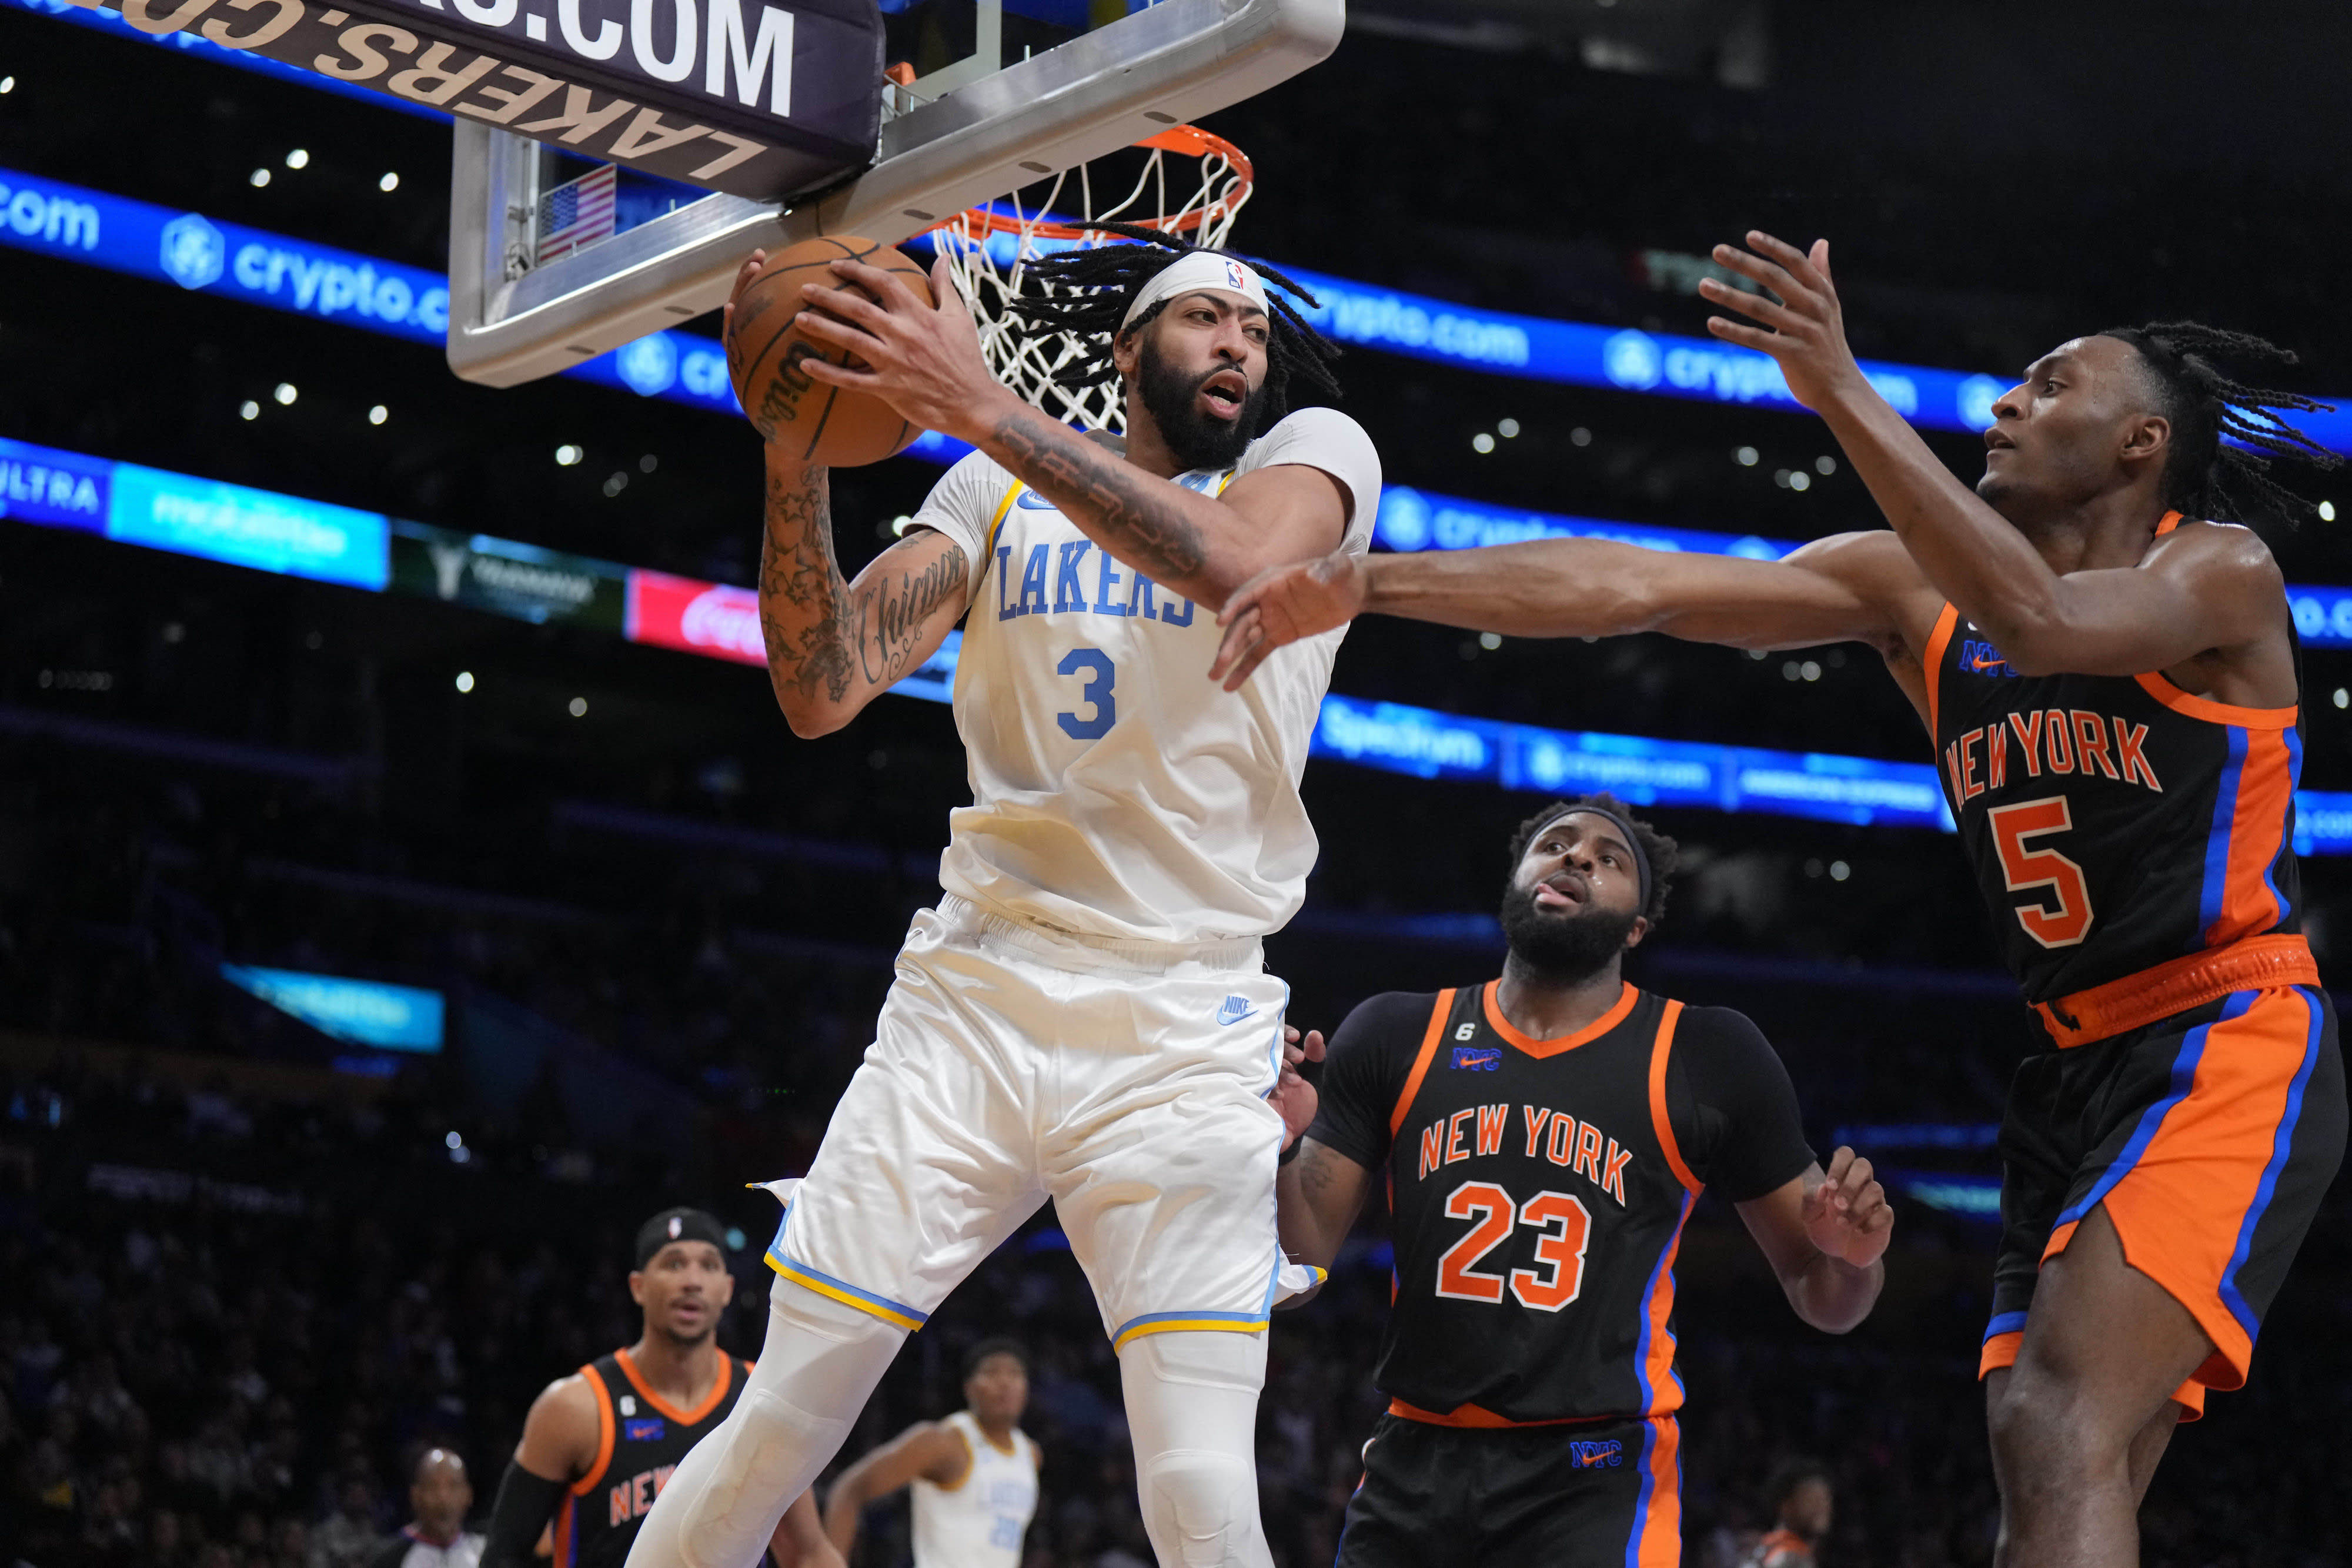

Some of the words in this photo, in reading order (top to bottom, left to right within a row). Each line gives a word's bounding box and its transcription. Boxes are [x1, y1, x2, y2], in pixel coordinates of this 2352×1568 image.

[1057, 648, 1116, 740] 3
[1946, 721, 2008, 814] NEW
[2007, 708, 2164, 793] YORK
[1987, 794, 2095, 950] 5
[1224, 995, 1250, 1015] NIKE
[1455, 1022, 1476, 1041] 6
[1449, 1047, 1502, 1072] NYC
[1418, 1103, 1509, 1182] NEW
[1523, 1104, 1633, 1209] YORK
[1435, 1180, 1592, 1313] 23
[1570, 1439, 1622, 1469] NYC
